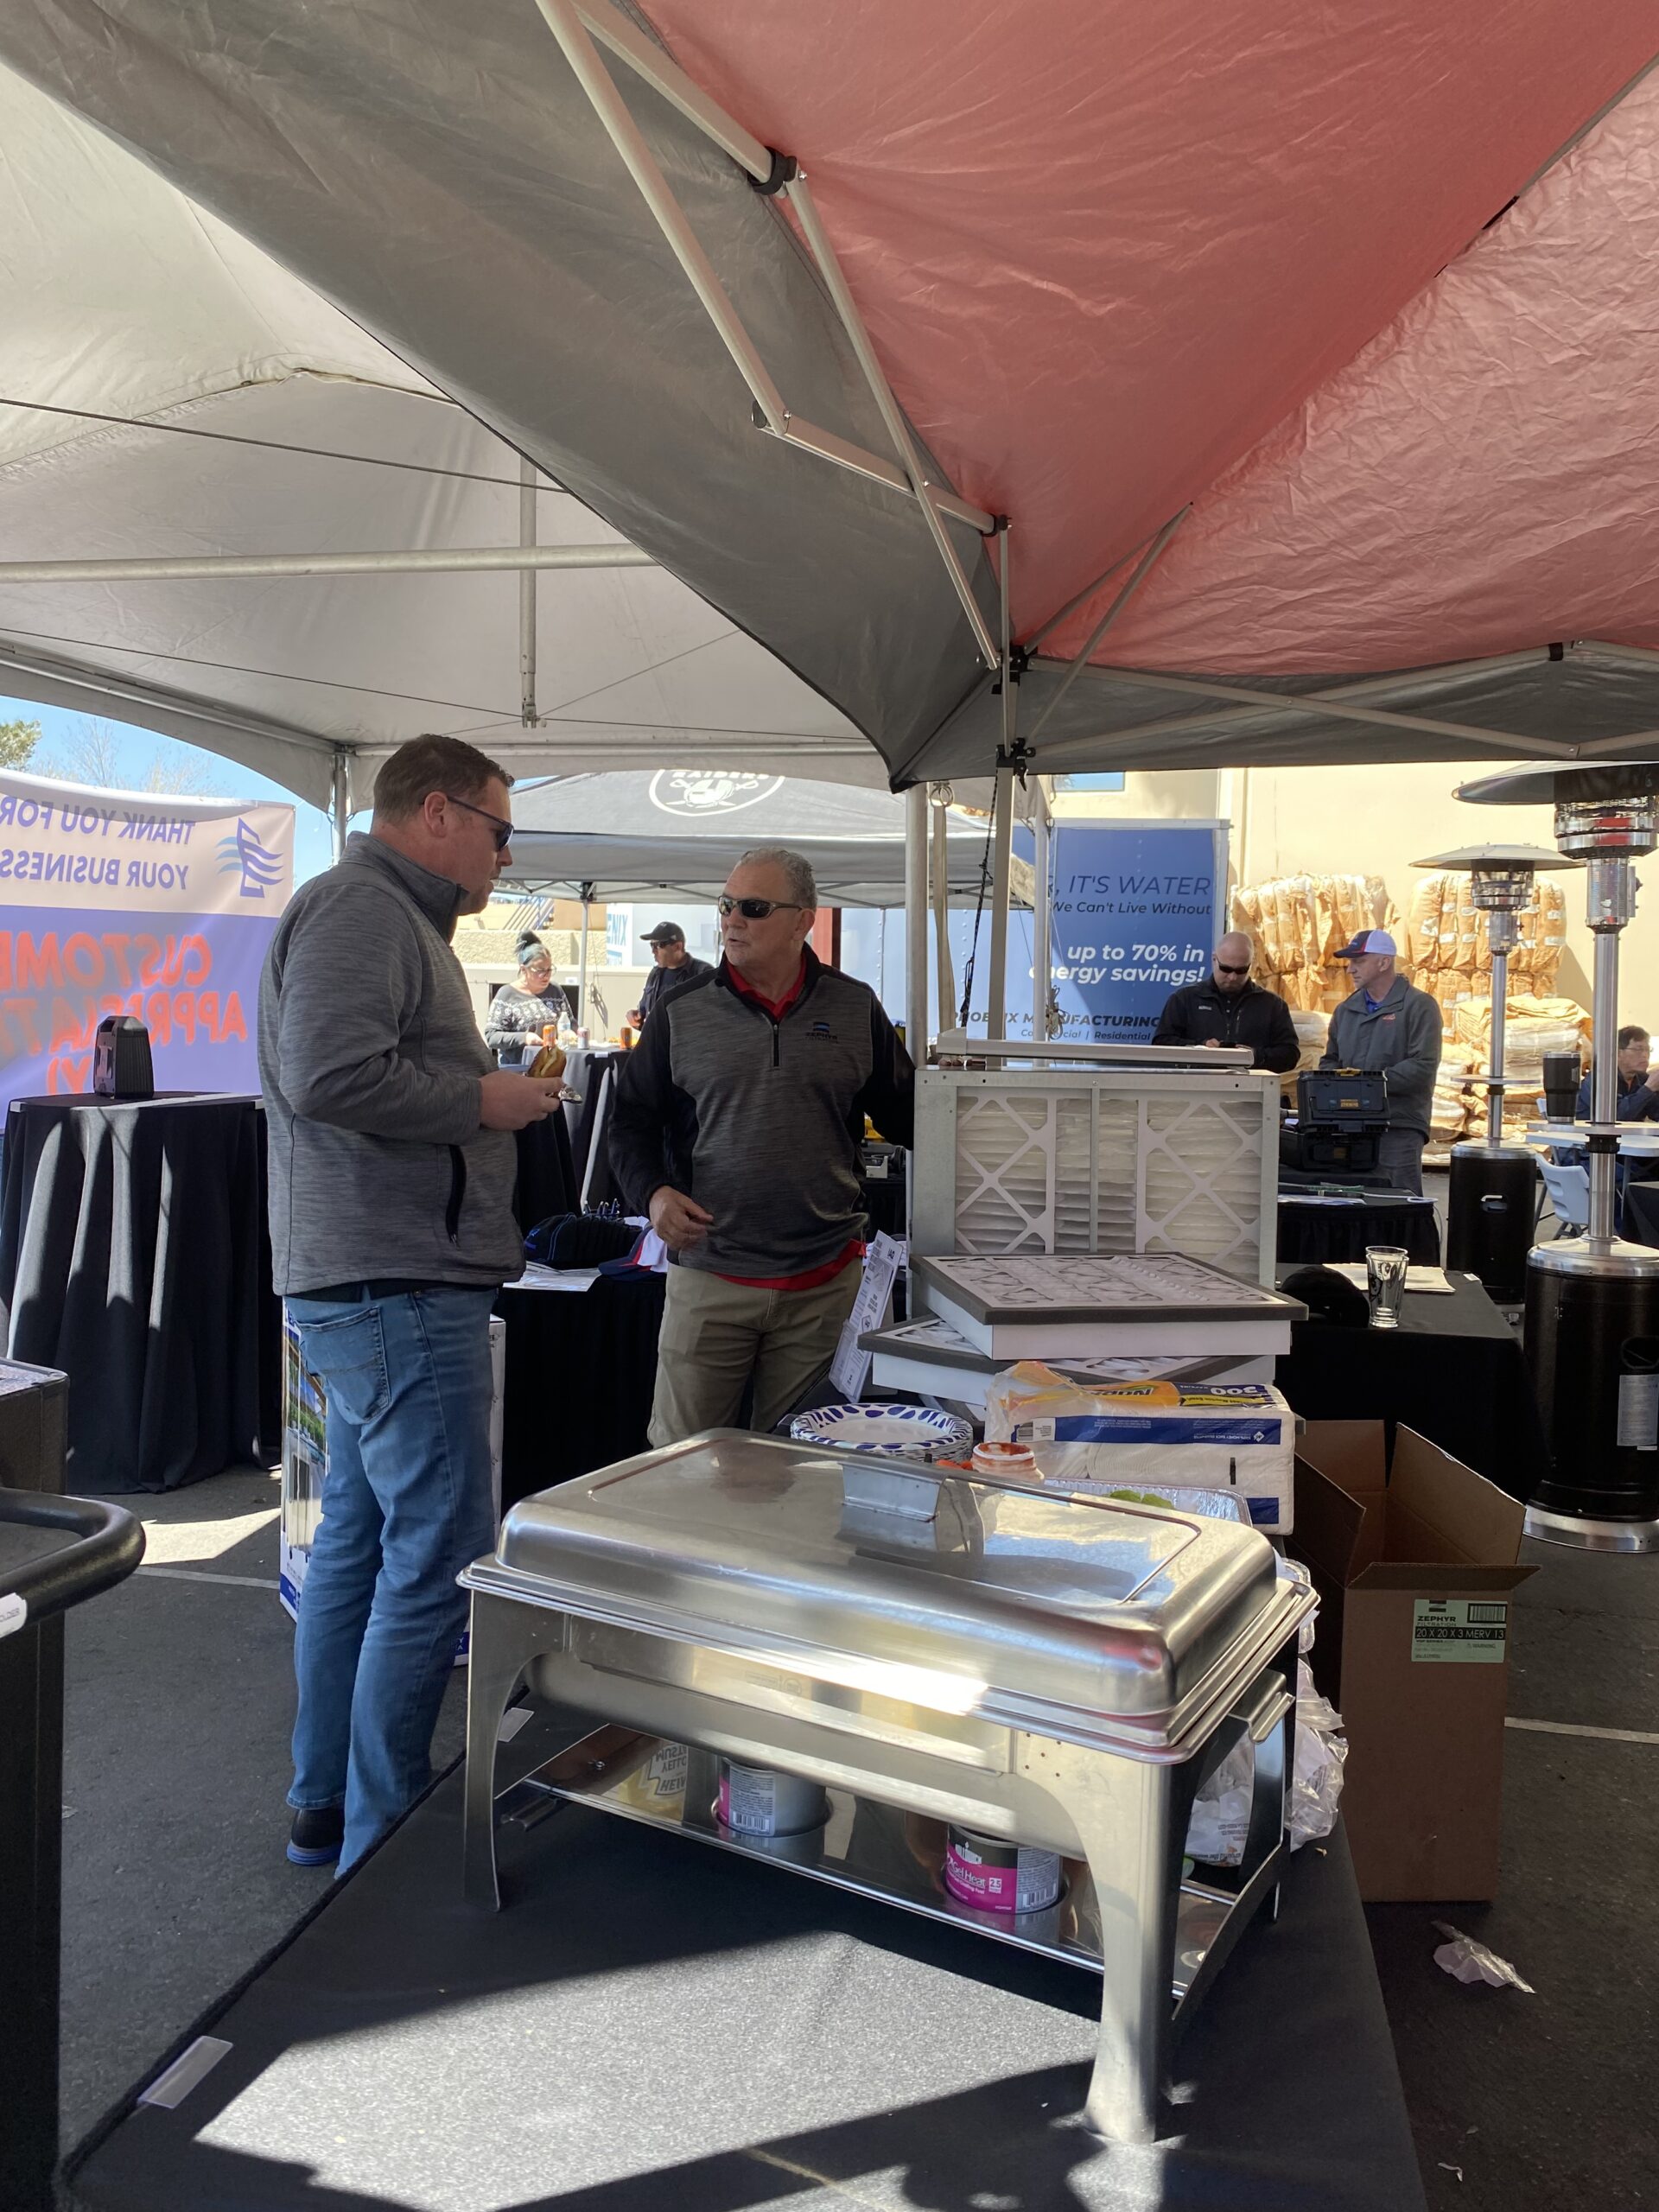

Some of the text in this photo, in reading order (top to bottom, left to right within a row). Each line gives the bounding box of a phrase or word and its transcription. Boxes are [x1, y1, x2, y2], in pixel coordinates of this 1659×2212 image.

[1069, 875, 1110, 895] IT'S
[1119, 875, 1211, 896] WATER
[1077, 901, 1114, 913] Can't
[1118, 901, 1147, 914] Live
[1150, 902, 1211, 916] Without
[1067, 944, 1205, 963] up to 70% in
[1110, 964, 1205, 986] savings!
[1094, 1031, 1151, 1041] Residential
[1210, 1385, 1258, 1395] 300
[1416, 1629, 1504, 1639] 20 X 20 X 3 MERV 13
